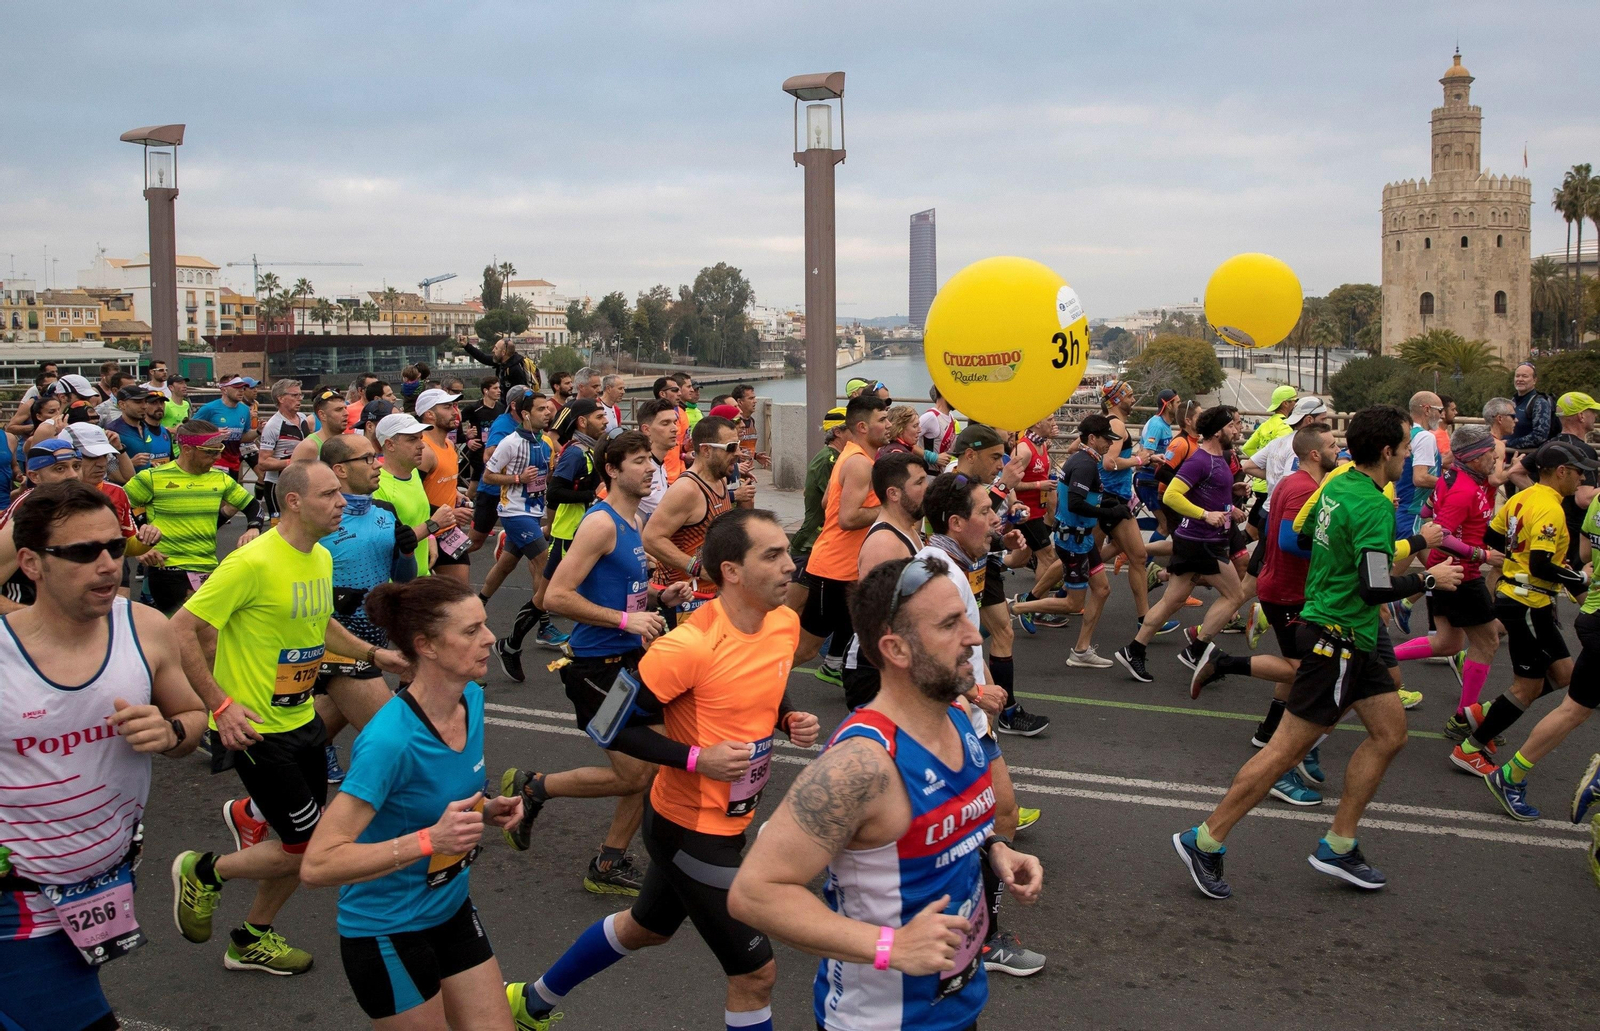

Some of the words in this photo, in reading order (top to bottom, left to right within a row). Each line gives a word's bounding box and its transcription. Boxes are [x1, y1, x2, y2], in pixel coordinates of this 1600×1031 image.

[943, 350, 1021, 367] Cruzcampo
[1051, 330, 1080, 369] 3h
[951, 370, 988, 384] Radler
[290, 577, 334, 620] RUN
[691, 600, 707, 608] ZUR
[302, 648, 324, 660] ZURIC
[12, 716, 125, 757] Popul
[756, 739, 771, 753] ZUR
[925, 814, 959, 845] C.A.
[935, 852, 950, 868] LA
[949, 831, 984, 862] PUEBLA
[65, 869, 119, 897] ZUICH
[66, 901, 117, 933] 5266
